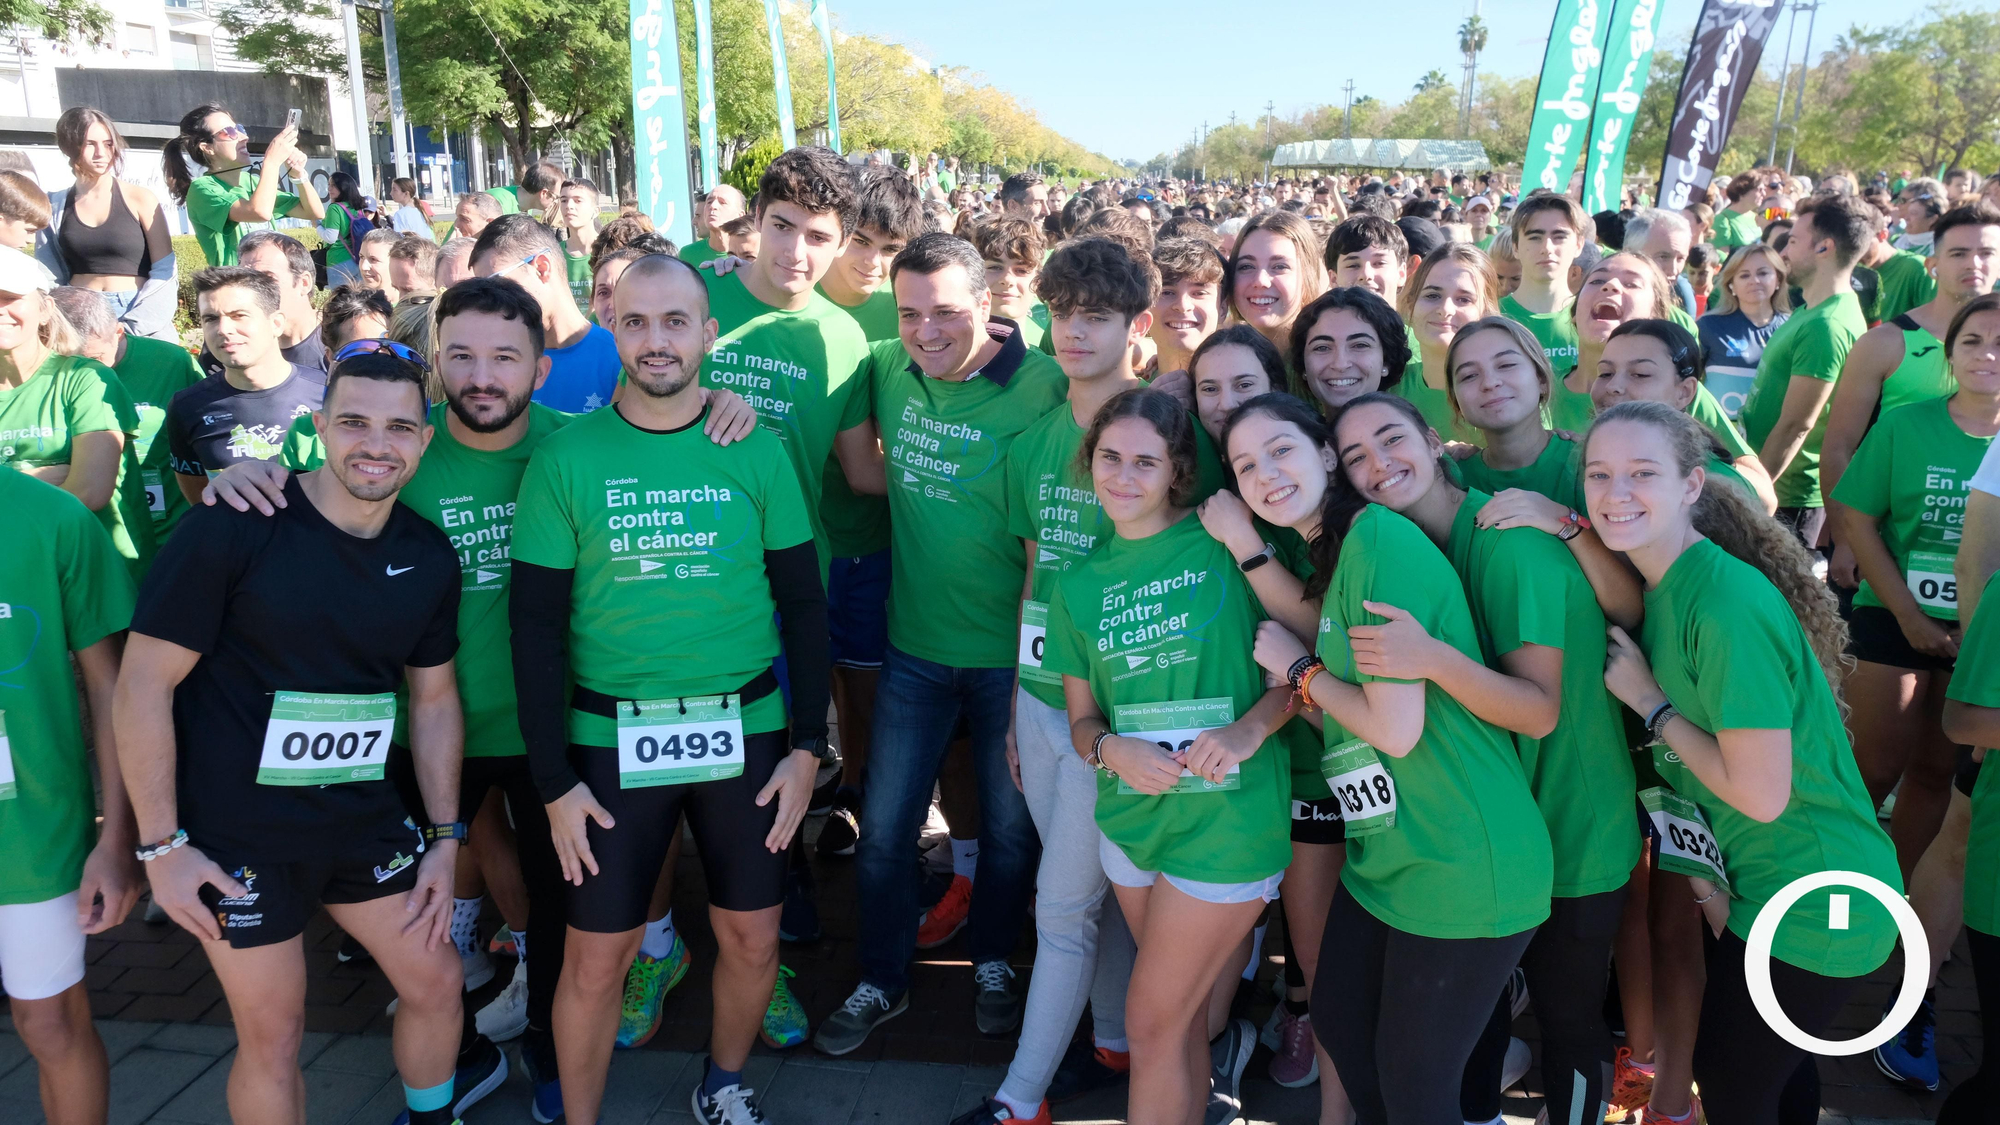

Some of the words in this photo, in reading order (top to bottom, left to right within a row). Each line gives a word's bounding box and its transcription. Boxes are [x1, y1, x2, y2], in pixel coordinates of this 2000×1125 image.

[1693, 18, 1747, 121] Inglés
[1678, 118, 1710, 184] Corte
[712, 346, 738, 364] En
[745, 354, 807, 380] marcha
[1544, 345, 1579, 358] arch
[710, 370, 771, 390] contra
[902, 405, 917, 426] En
[921, 416, 982, 442] marcha
[898, 428, 940, 452] contra
[892, 444, 904, 460] el
[906, 451, 960, 476] cáncer
[1927, 465, 1956, 474] Córdoba
[606, 478, 638, 486] Córdoba
[1925, 474, 1954, 490] En
[440, 495, 474, 506] Córdoba
[606, 489, 637, 508] En
[646, 484, 732, 504] marcha
[442, 508, 474, 528] En
[608, 508, 684, 530] contra
[1922, 508, 1940, 522] el
[610, 533, 630, 552] el
[638, 530, 718, 550] cáncer
[1041, 524, 1096, 548] cáncer
[614, 574, 667, 582] Responsablemente
[1103, 580, 1128, 594] Córdoba
[1102, 594, 1125, 613] En
[1132, 570, 1207, 601] marcha
[1099, 602, 1162, 631] contra
[1098, 631, 1114, 652] el
[1122, 612, 1189, 645] cáncer
[1124, 646, 1147, 655] ESPAÑOLA
[1166, 634, 1184, 642] CÁNCER
[280, 695, 313, 703] Córdoba
[282, 730, 382, 761] 0007
[635, 730, 733, 763] 0493
[1338, 774, 1391, 813] 0318
